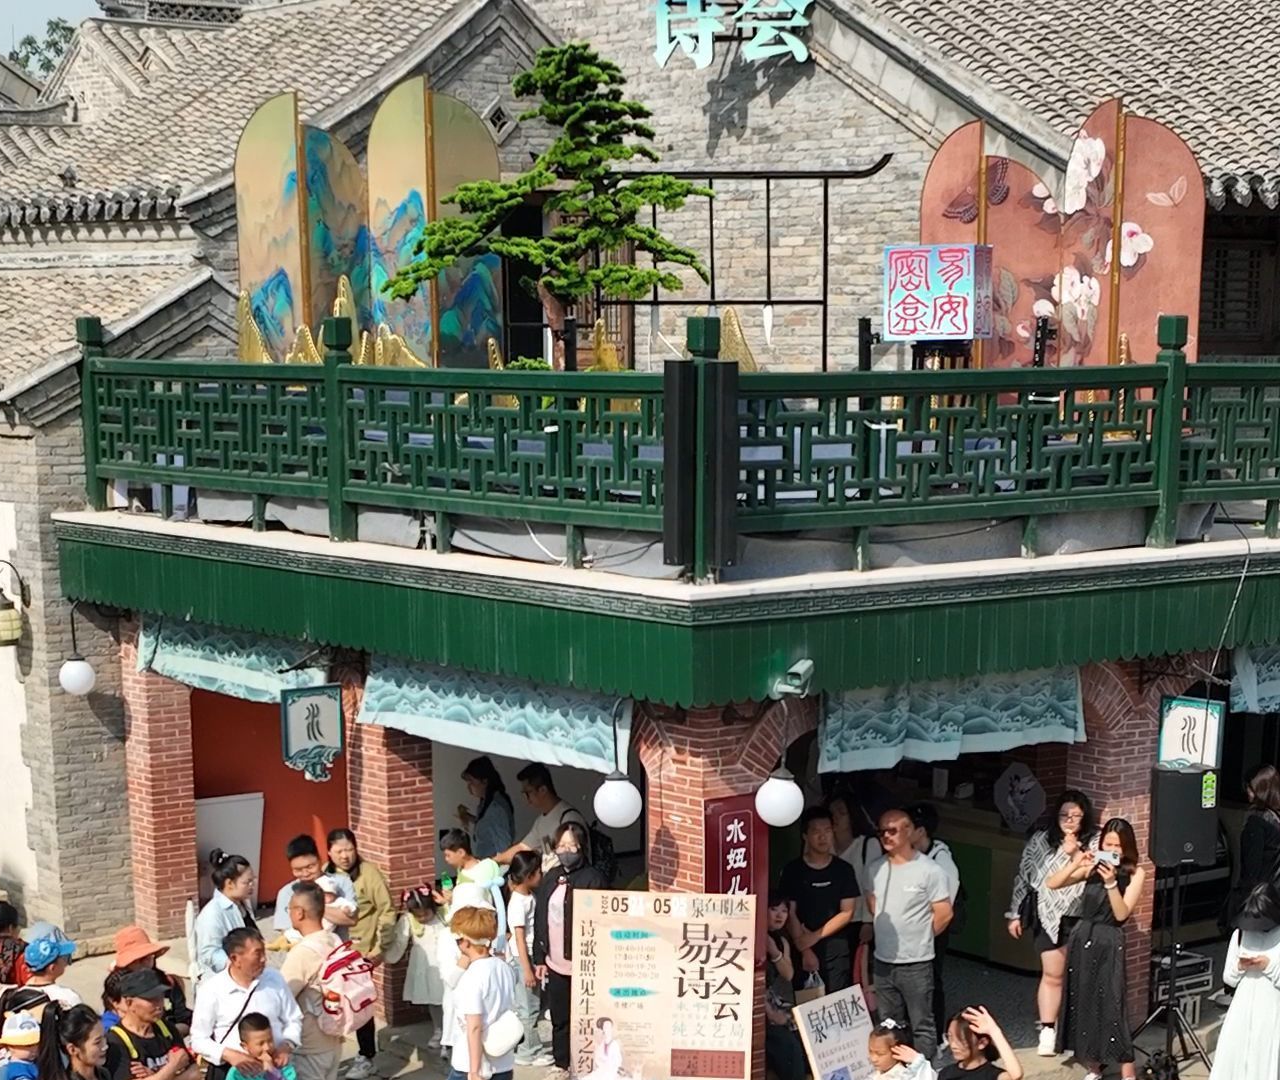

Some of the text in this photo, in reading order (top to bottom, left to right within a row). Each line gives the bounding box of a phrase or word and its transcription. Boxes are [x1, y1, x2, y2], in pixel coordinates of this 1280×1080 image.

[611, 897, 629, 912] 05
[653, 898, 671, 915] 05
[692, 898, 750, 918] 泉在明水
[577, 920, 597, 1074] 诗歌照见生活之约
[807, 994, 866, 1044] 泉在明水
